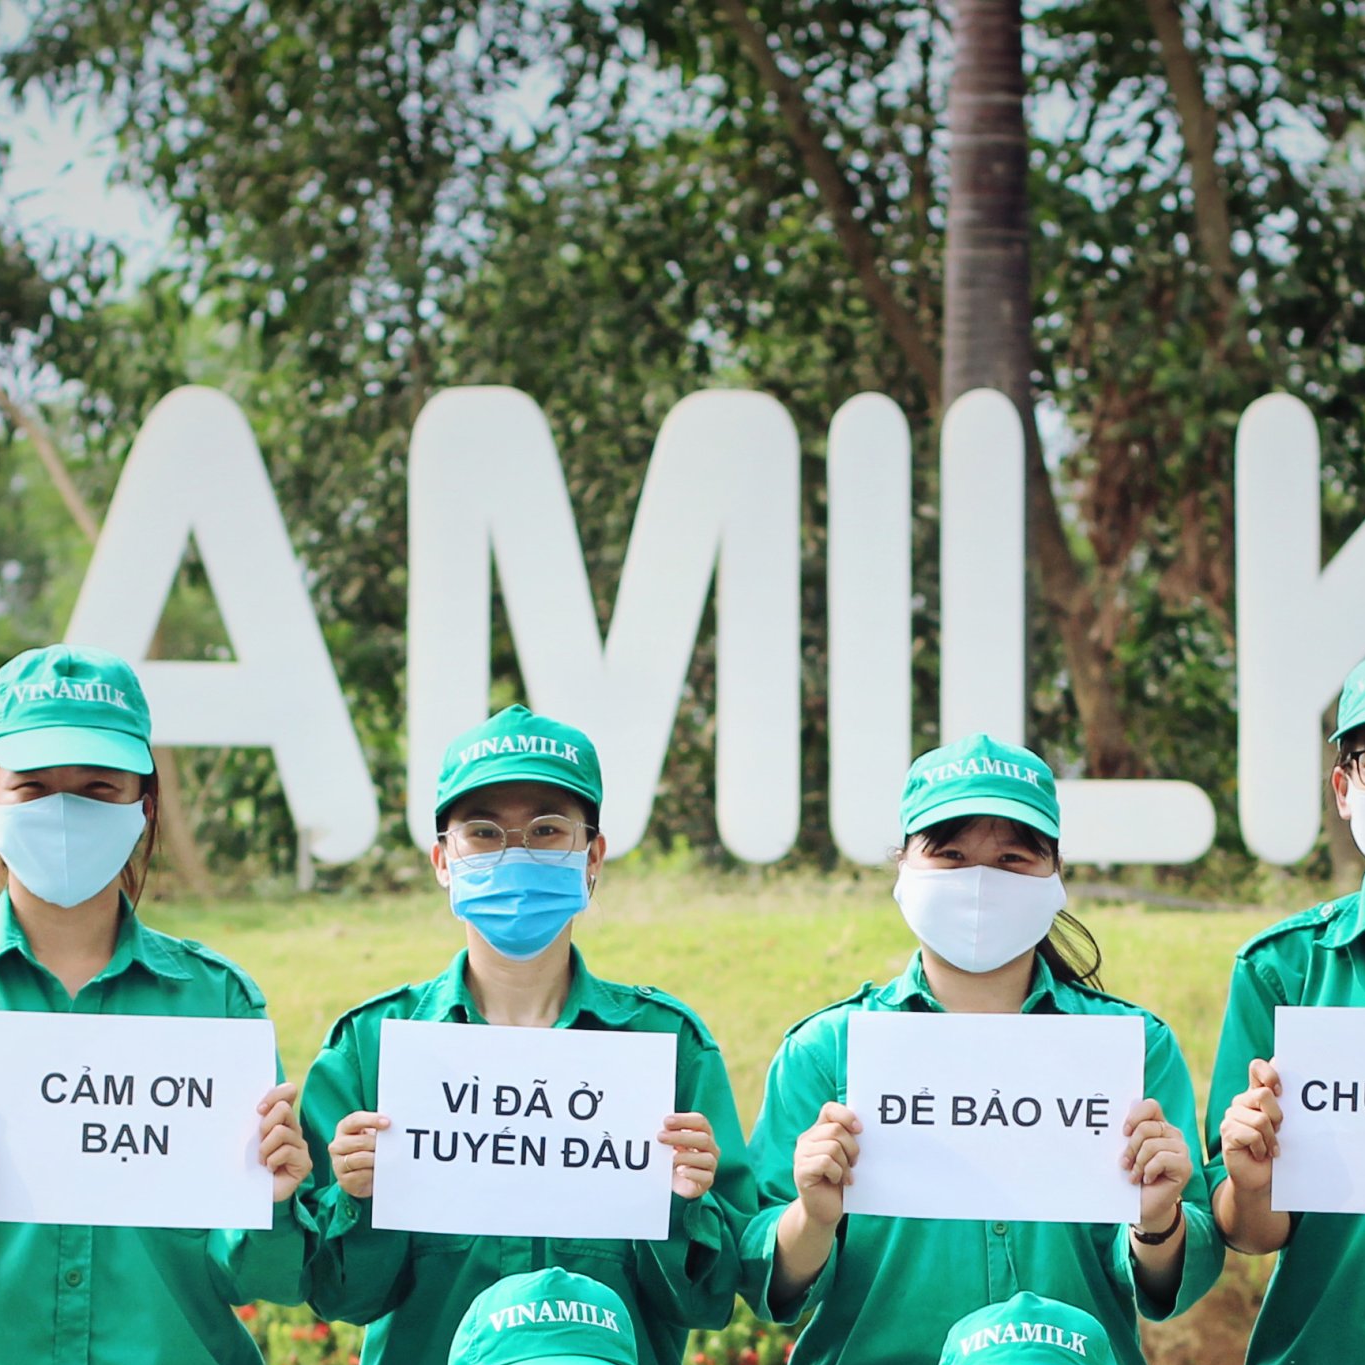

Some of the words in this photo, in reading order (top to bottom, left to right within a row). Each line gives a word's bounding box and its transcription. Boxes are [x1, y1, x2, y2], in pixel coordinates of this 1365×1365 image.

[13, 677, 129, 710] VINAMILK
[460, 734, 579, 765] VINAMILK
[922, 757, 1039, 788] VINAMILK
[40, 1066, 134, 1106] CẢM
[150, 1076, 213, 1108] ƠN
[441, 1075, 480, 1115] VÌ
[492, 1079, 553, 1119] ĐÃ
[568, 1081, 604, 1121] Ở
[877, 1086, 935, 1126] ĐỂ
[951, 1088, 1042, 1128] BẢO
[1056, 1091, 1110, 1136] VỆ
[81, 1122, 169, 1163] BẠN
[405, 1126, 547, 1167] TUYẾN
[560, 1130, 651, 1171] ĐẦU
[489, 1300, 620, 1333] VINAMILK
[960, 1322, 1088, 1356] VINAMILK
